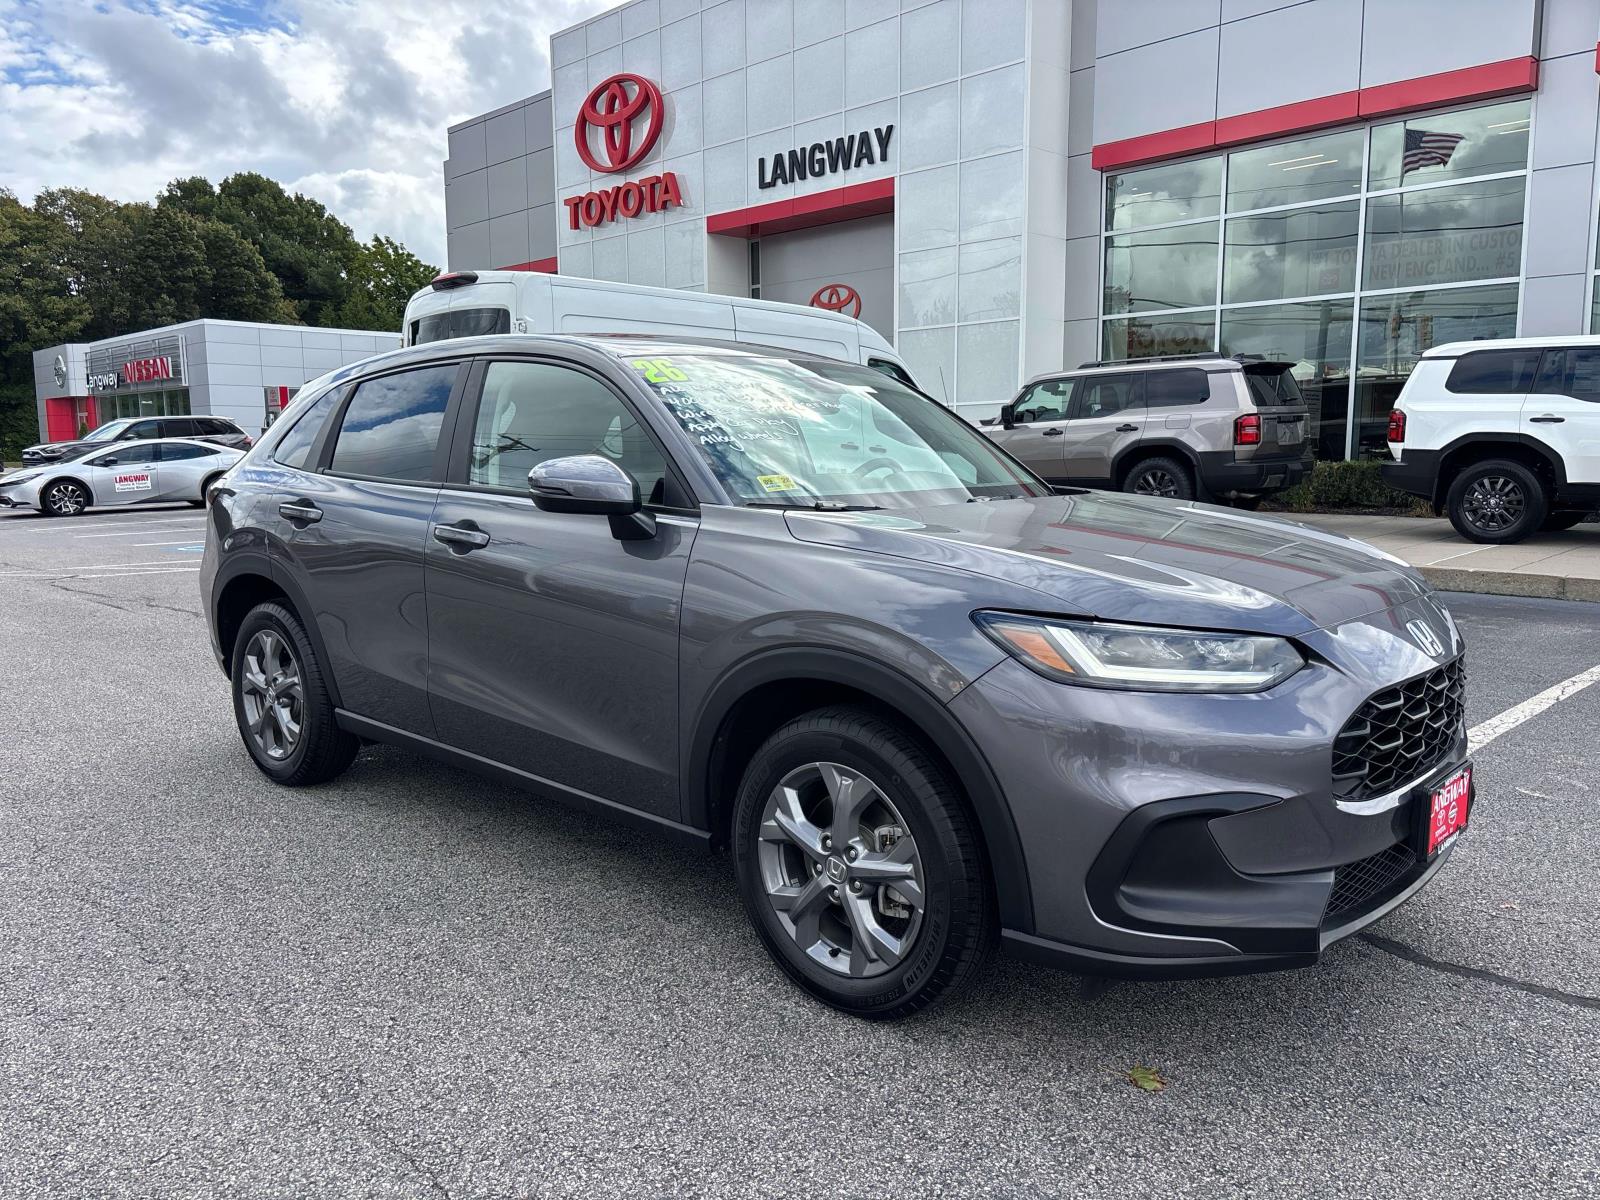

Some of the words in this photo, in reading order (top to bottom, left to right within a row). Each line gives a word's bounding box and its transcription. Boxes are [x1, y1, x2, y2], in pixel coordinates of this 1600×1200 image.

[758, 124, 895, 190] LANGWAY
[564, 172, 683, 230] TOYOTA
[1391, 239, 1442, 259] DEALER
[1447, 236, 1465, 253] IN
[86, 372, 118, 390] Langway
[124, 356, 173, 384] NISSAN
[631, 358, 689, 383] 26
[114, 474, 149, 484] LANGWAY
